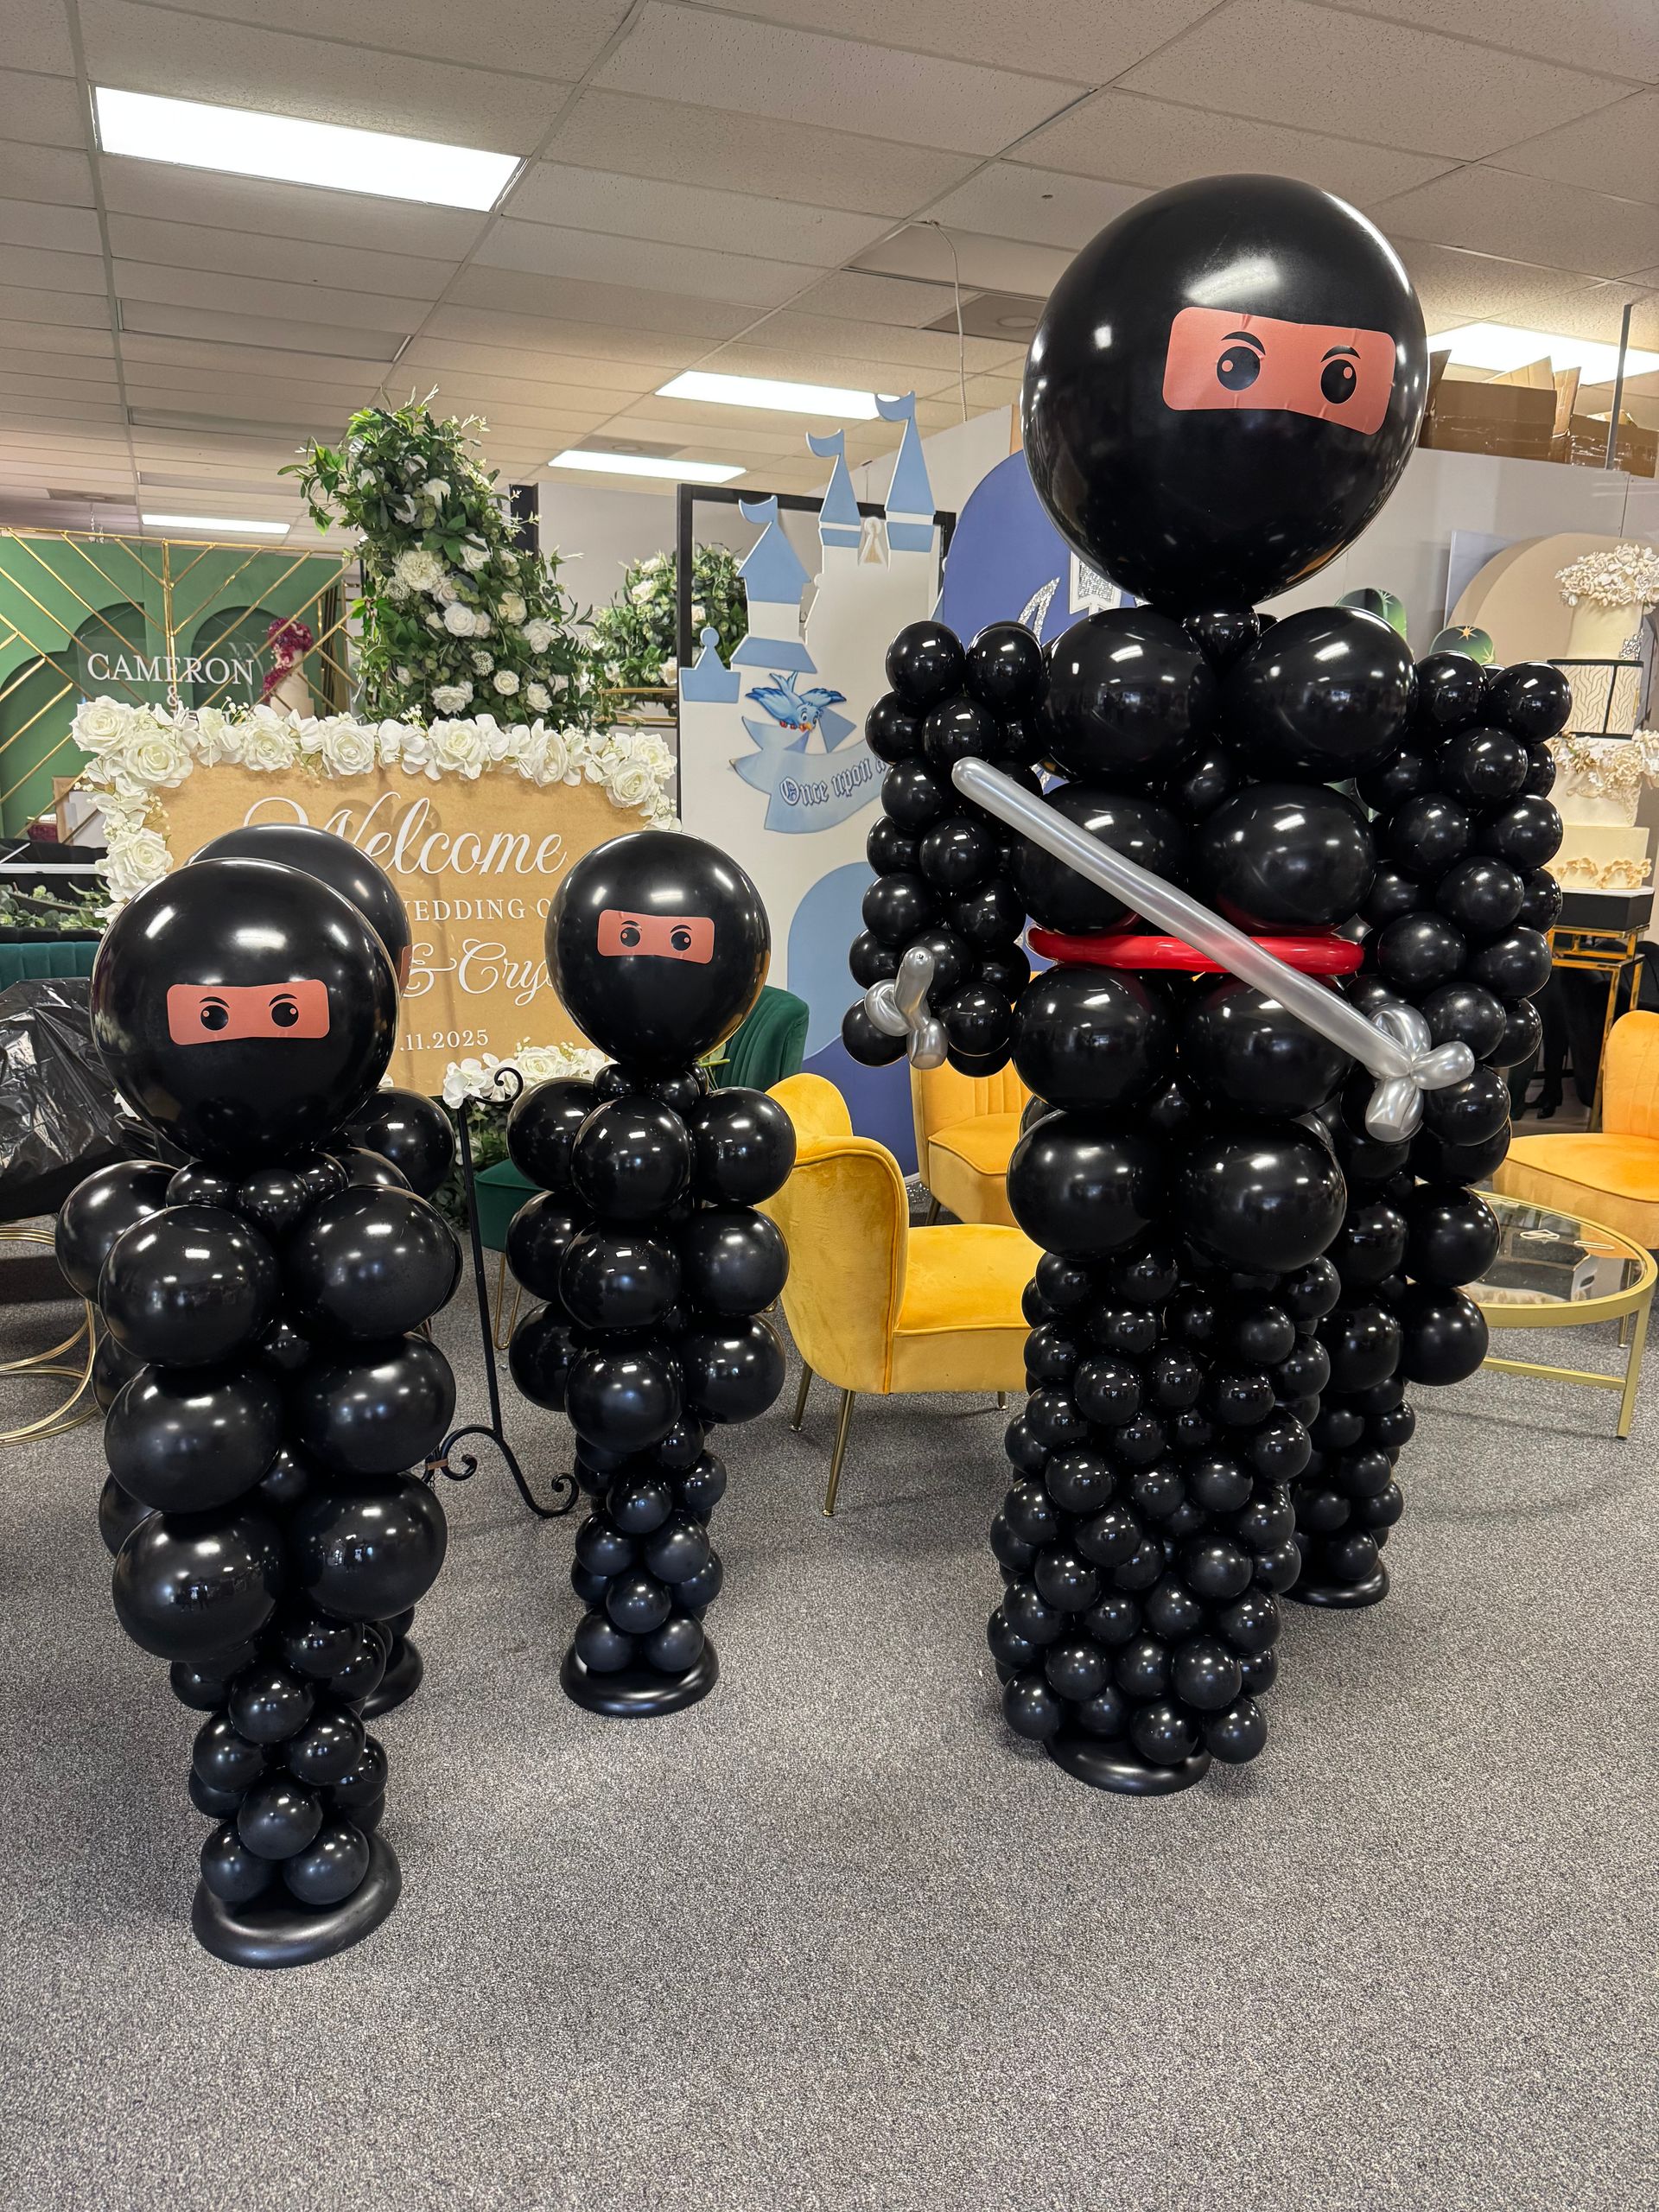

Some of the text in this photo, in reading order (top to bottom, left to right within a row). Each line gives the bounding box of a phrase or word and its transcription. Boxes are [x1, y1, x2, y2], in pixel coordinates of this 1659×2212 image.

[87, 652, 255, 686] CAMERON
[779, 776, 830, 806] Once
[831, 758, 873, 798] upon
[402, 898, 526, 922] EDDING
